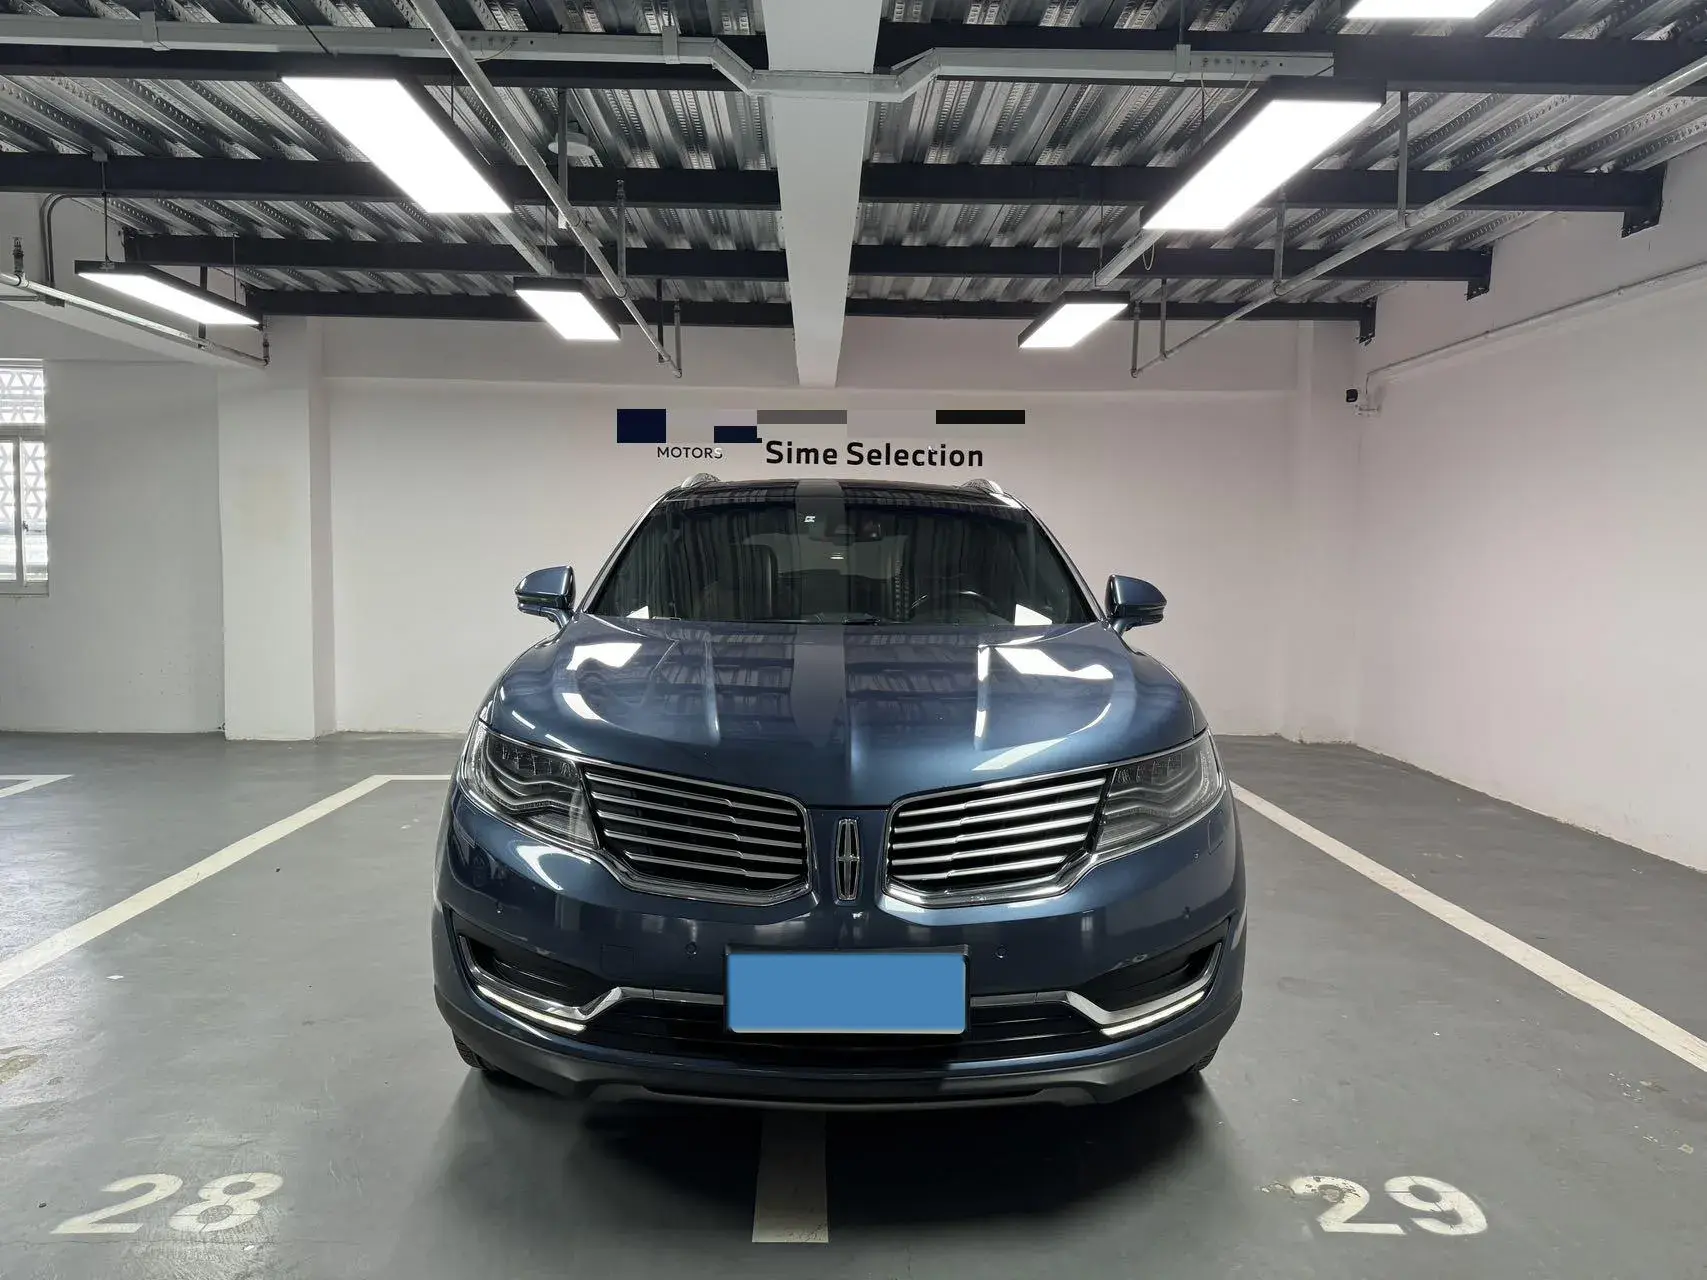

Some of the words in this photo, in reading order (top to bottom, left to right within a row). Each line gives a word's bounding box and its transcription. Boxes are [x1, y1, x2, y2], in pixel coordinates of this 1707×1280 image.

[657, 446, 723, 459] MOTORS
[765, 440, 838, 466] Sime
[846, 441, 984, 468] Selection
[49, 1171, 284, 1235] 28
[1288, 1175, 1488, 1236] 29
